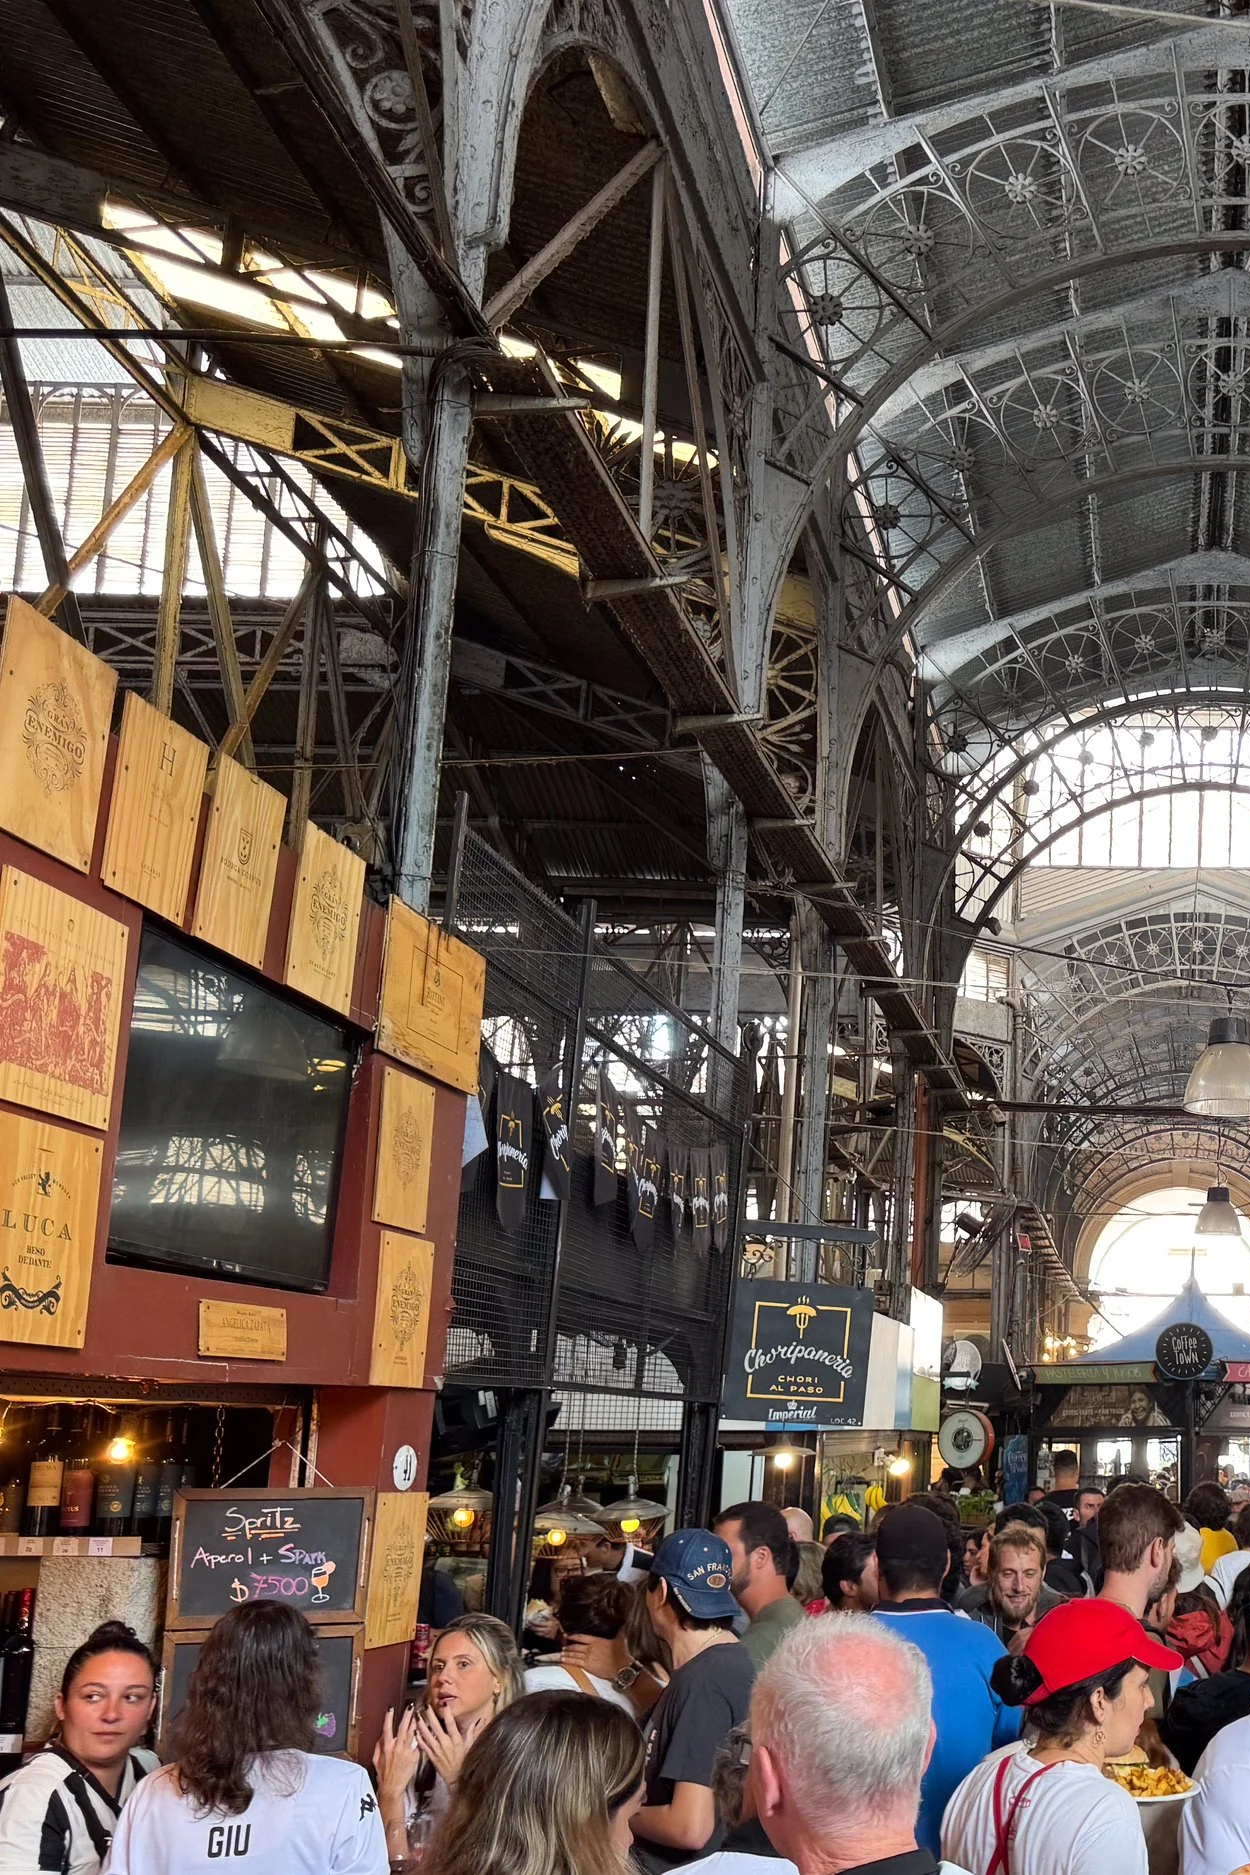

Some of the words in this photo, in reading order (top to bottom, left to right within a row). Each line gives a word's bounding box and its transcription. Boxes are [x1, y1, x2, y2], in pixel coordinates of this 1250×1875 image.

[27, 714, 83, 759] ENEMIGO
[159, 741, 176, 777] H
[313, 901, 346, 925] ENEMIGO
[1, 1208, 73, 1241] LUCA
[26, 1245, 46, 1257] BESO
[769, 1384, 784, 1392] AL
[790, 1385, 824, 1394] PASO
[777, 1375, 818, 1384] CHORI
[768, 1406, 817, 1421] Imperial
[191, 1546, 252, 1569] Aperol
[687, 1565, 705, 1581] SAN
[207, 1823, 252, 1859] GIU
